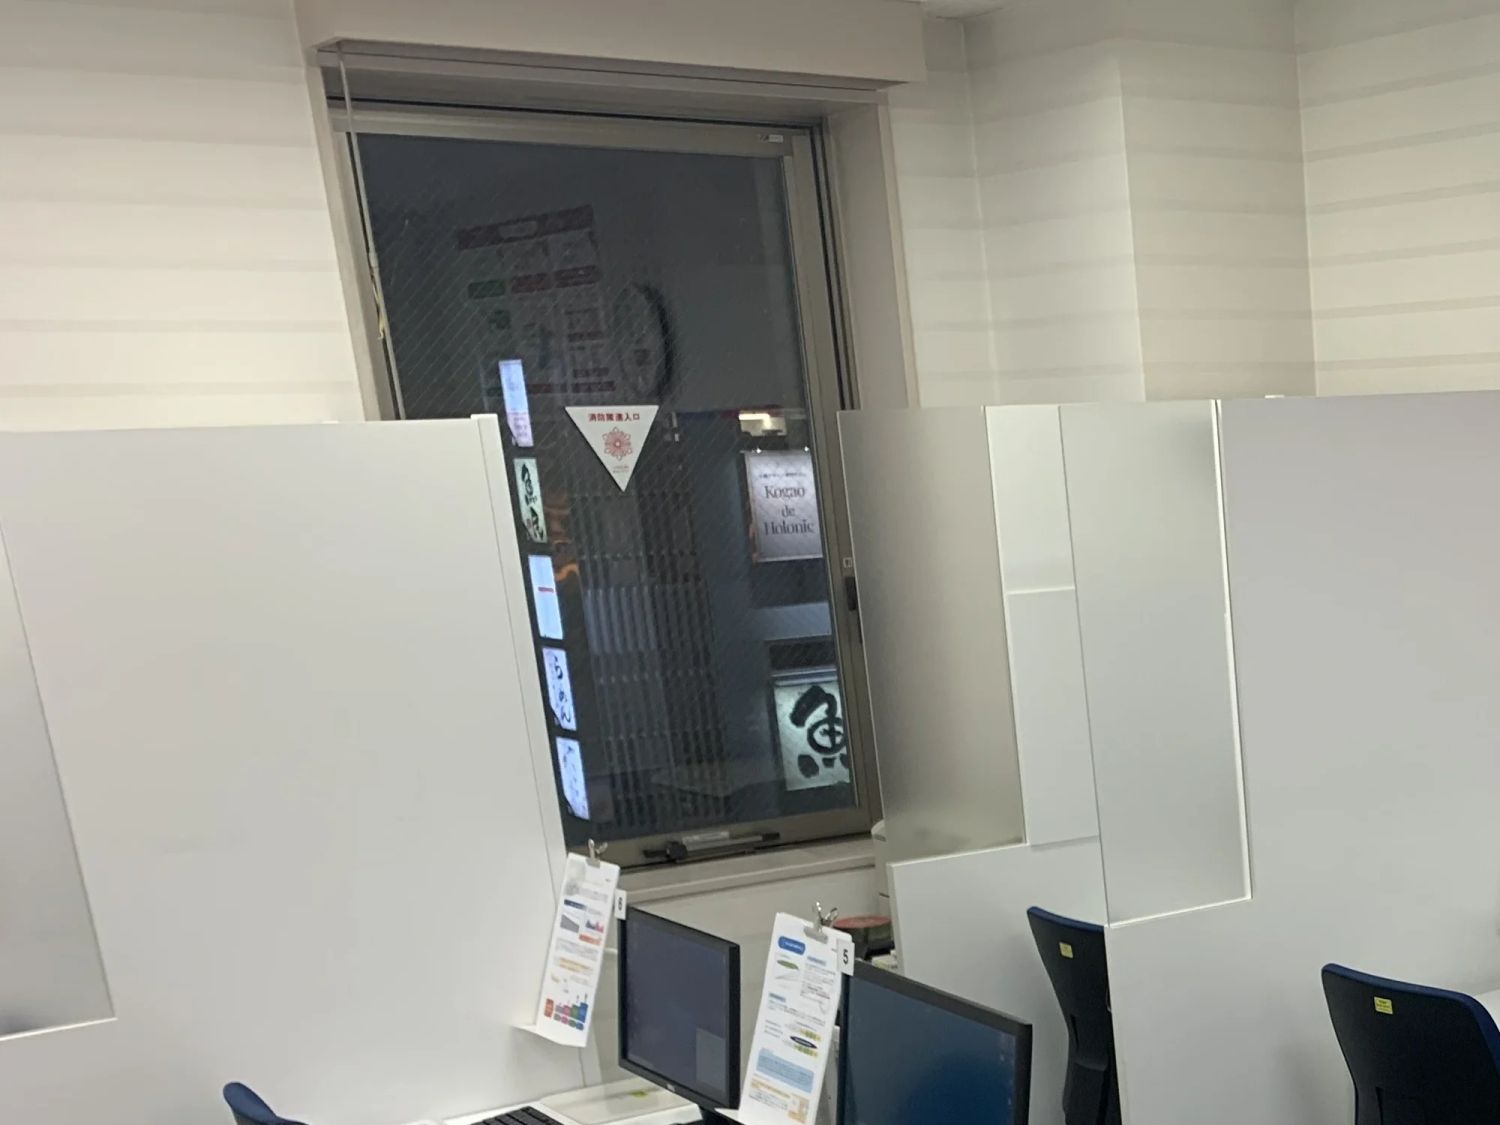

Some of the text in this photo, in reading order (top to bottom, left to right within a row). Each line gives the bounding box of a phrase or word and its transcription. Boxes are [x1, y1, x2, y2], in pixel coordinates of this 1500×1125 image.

[765, 485, 805, 500] Kogao
[782, 506, 795, 516] de
[765, 521, 814, 535] Holonic
[842, 948, 849, 965] 5
